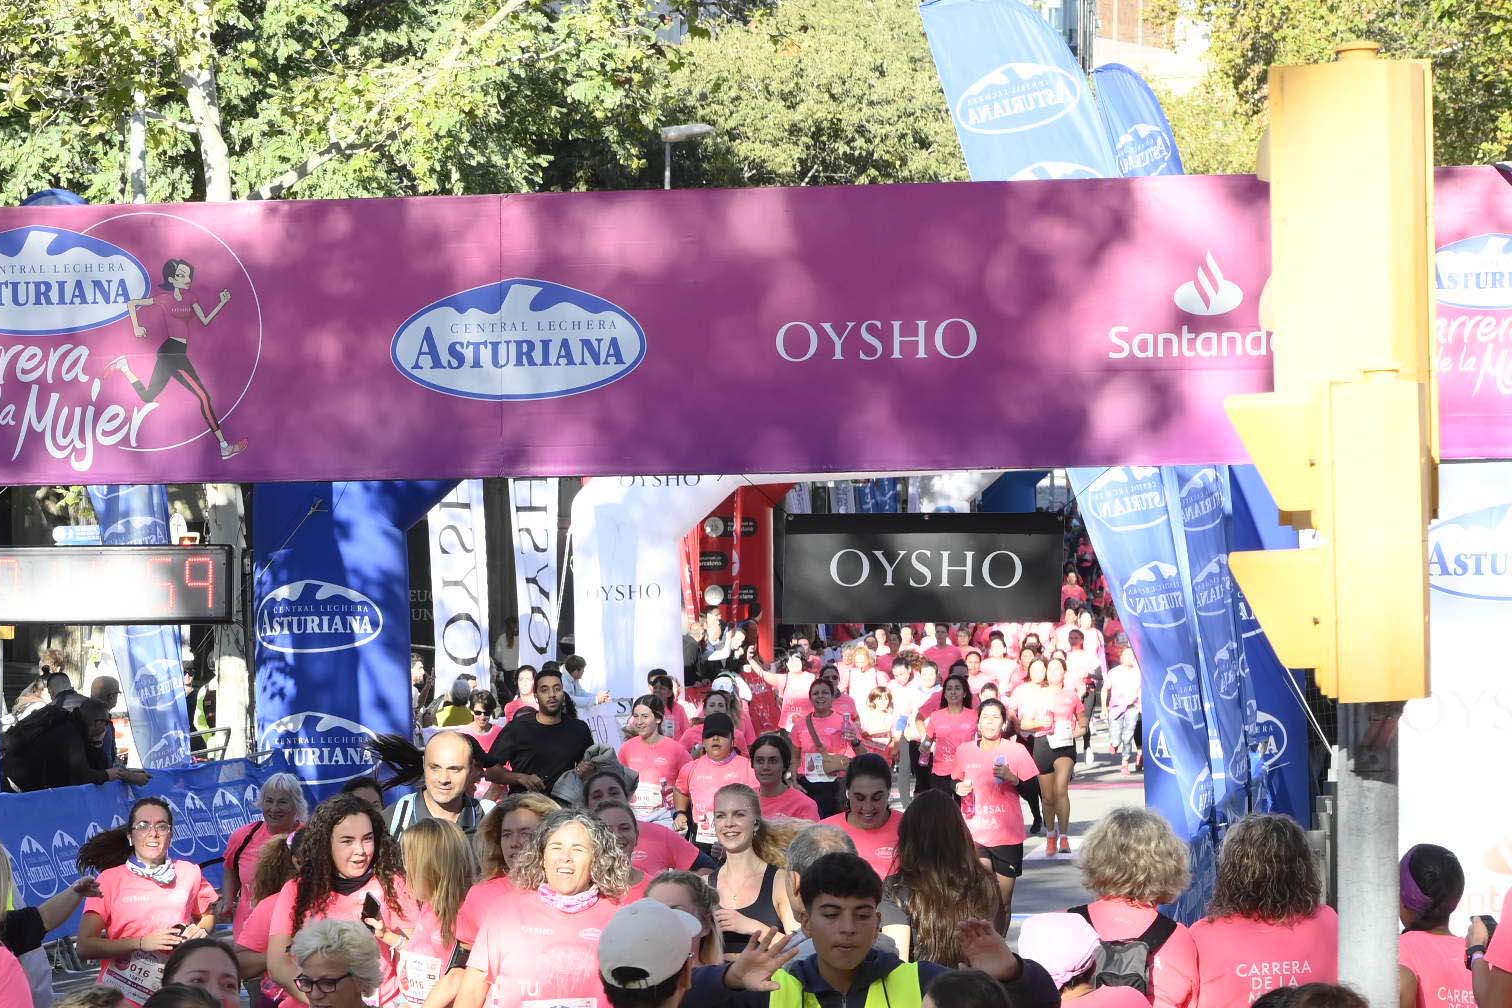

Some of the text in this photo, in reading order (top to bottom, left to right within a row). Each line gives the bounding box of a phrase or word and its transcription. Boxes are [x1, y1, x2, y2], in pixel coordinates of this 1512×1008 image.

[53, 262, 126, 274] LECHERA
[450, 318, 617, 334] CENTRAL LECHERA
[410, 325, 627, 371] ASTURIANA
[775, 317, 978, 363] OYSHO
[11, 378, 160, 471] Mujer
[829, 548, 1023, 590] OYSHO
[586, 583, 662, 602] OYSHO
[273, 604, 369, 614] CENTRAL LECHERA
[261, 609, 374, 637] ASTURIANA
[274, 737, 316, 745] CENTRAL
[129, 963, 150, 978] 016
[1236, 960, 1313, 978] CARRERA
[1252, 977, 1273, 990] DE
